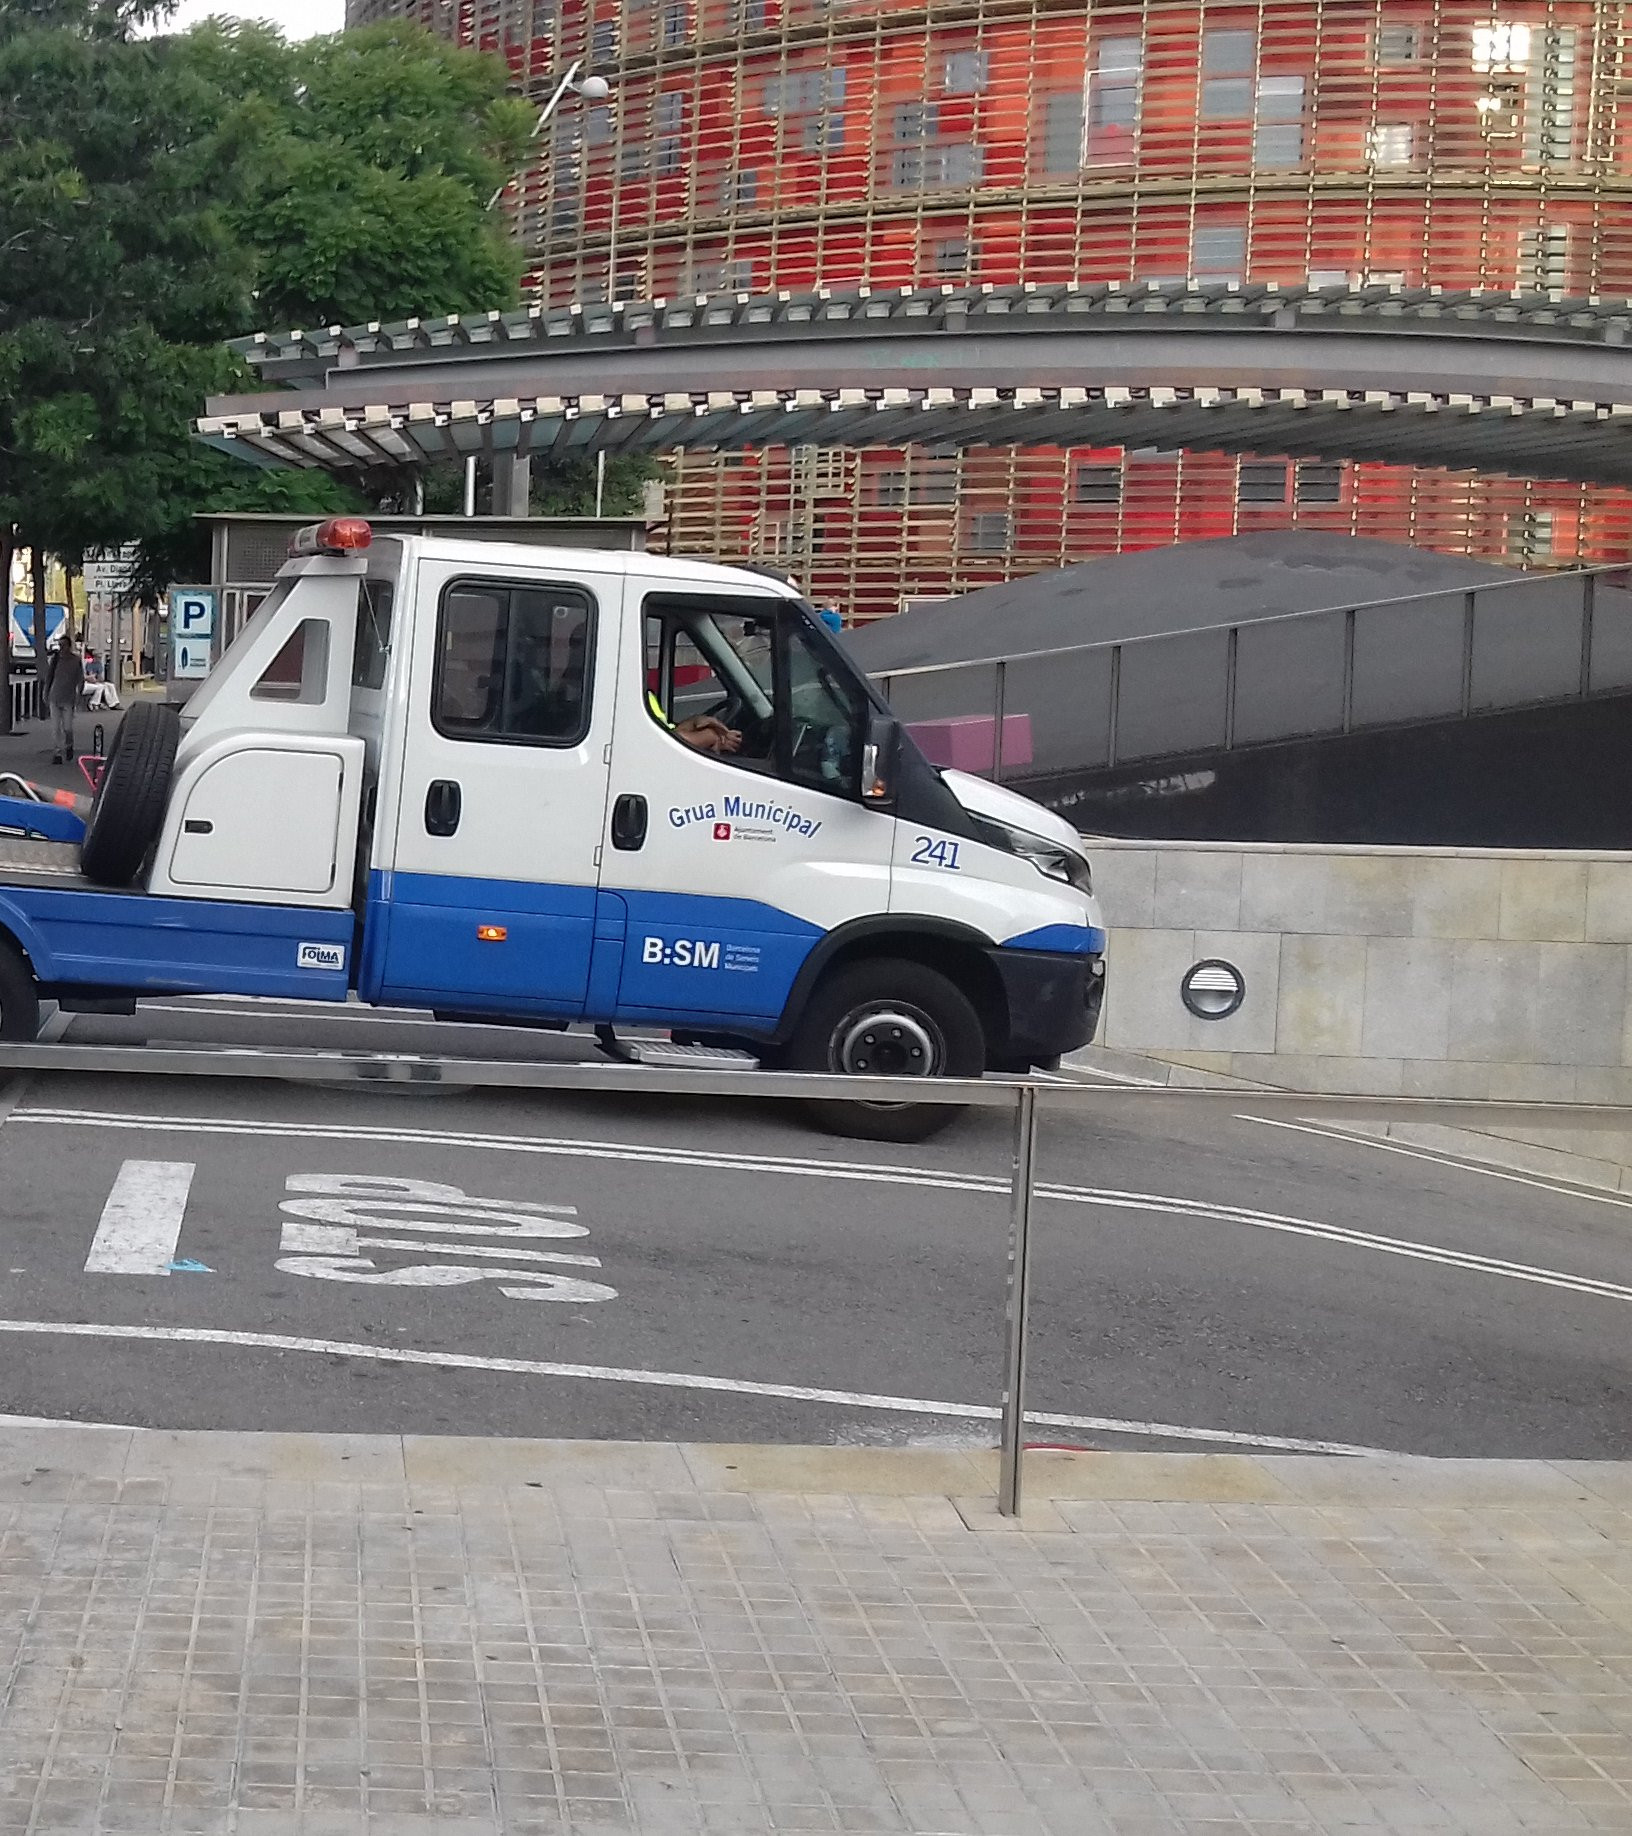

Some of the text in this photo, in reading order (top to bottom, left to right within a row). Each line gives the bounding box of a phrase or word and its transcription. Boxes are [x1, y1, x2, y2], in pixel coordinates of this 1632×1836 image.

[183, 601, 206, 629] P
[669, 796, 822, 839] Grua Municipal
[911, 836, 960, 869] 241
[643, 936, 721, 969] B:SM
[273, 1173, 619, 1303] STOP
